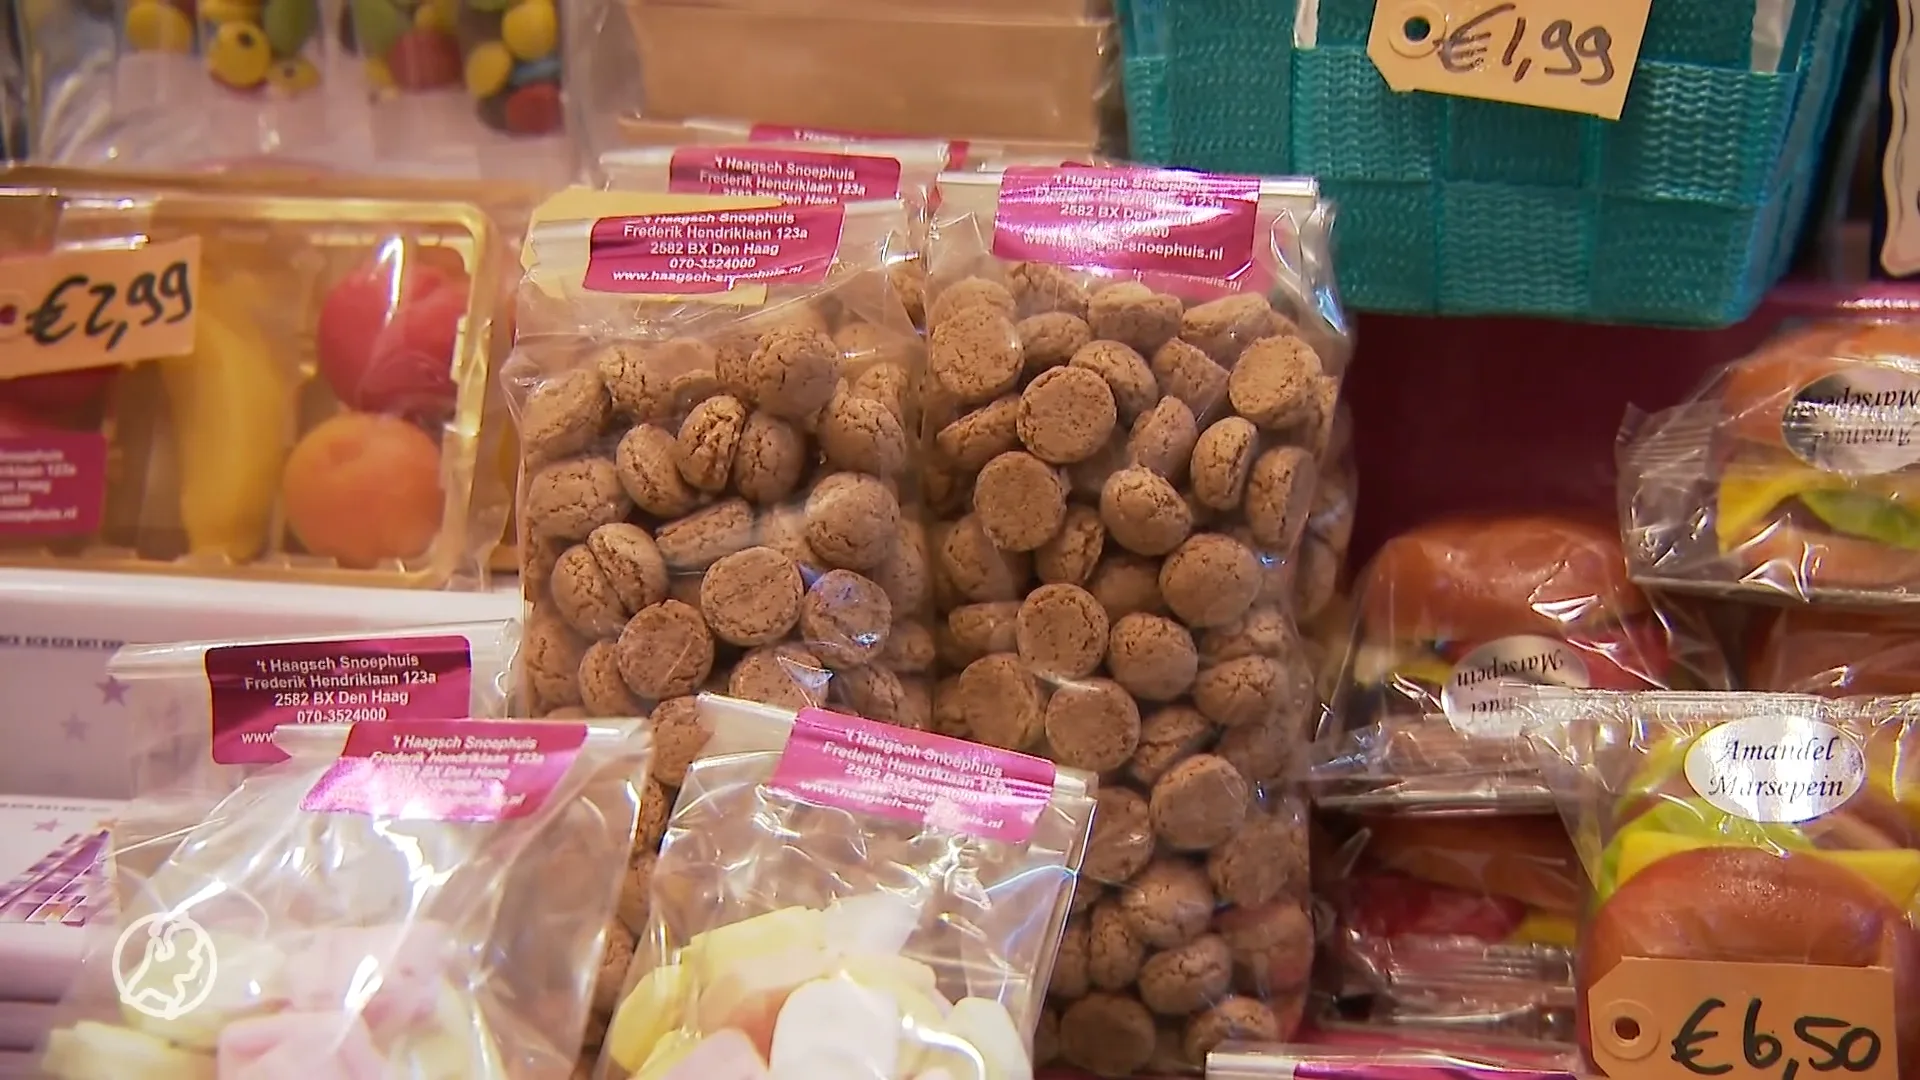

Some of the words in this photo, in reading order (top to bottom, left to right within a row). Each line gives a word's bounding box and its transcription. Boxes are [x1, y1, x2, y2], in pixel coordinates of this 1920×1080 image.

[1432, 2, 1615, 86] €1,99
[726, 155, 783, 175] Haagsch
[786, 161, 855, 181] Snoephuis
[700, 169, 753, 188] Frederik
[756, 174, 833, 195] Hendriklaan
[837, 181, 866, 199] 123a
[719, 211, 796, 226] Snoephuis
[1060, 203, 1095, 217] 2582
[1097, 206, 1120, 219] BX
[1123, 207, 1153, 221] Den
[624, 224, 684, 239] Frederik
[686, 225, 772, 240] Hendriklaan
[776, 227, 808, 240] 123a
[650, 241, 684, 255] 2582
[687, 242, 708, 255] BX
[712, 242, 740, 255] Den
[744, 242, 780, 257] Haag
[668, 257, 757, 269] 070-3524000
[612, 264, 805, 285] www.haagsch-snhuis.nl
[24, 260, 193, 353] €2,99
[256, 660, 267, 674] 't
[270, 656, 336, 675] Haagsch
[340, 653, 420, 671] Snoephuis
[1457, 649, 1565, 691] Marsepein
[244, 675, 307, 690] Frederik
[310, 671, 399, 688] Hendriklaan
[403, 669, 437, 685] 123a
[275, 691, 310, 707] 2582
[313, 690, 335, 705] BX
[339, 689, 368, 705] Den
[371, 688, 409, 706] Haag
[297, 707, 387, 724] 070-3524000
[403, 734, 463, 752] Haagsch
[464, 734, 538, 752] Snoephuis
[823, 740, 884, 767] Frederik
[1715, 736, 1840, 763] Amandel
[855, 730, 921, 759] Haagsch
[922, 748, 1004, 779] Snoephuis
[1708, 774, 1844, 804] Marsepein
[1670, 997, 1883, 1080] €6,50
